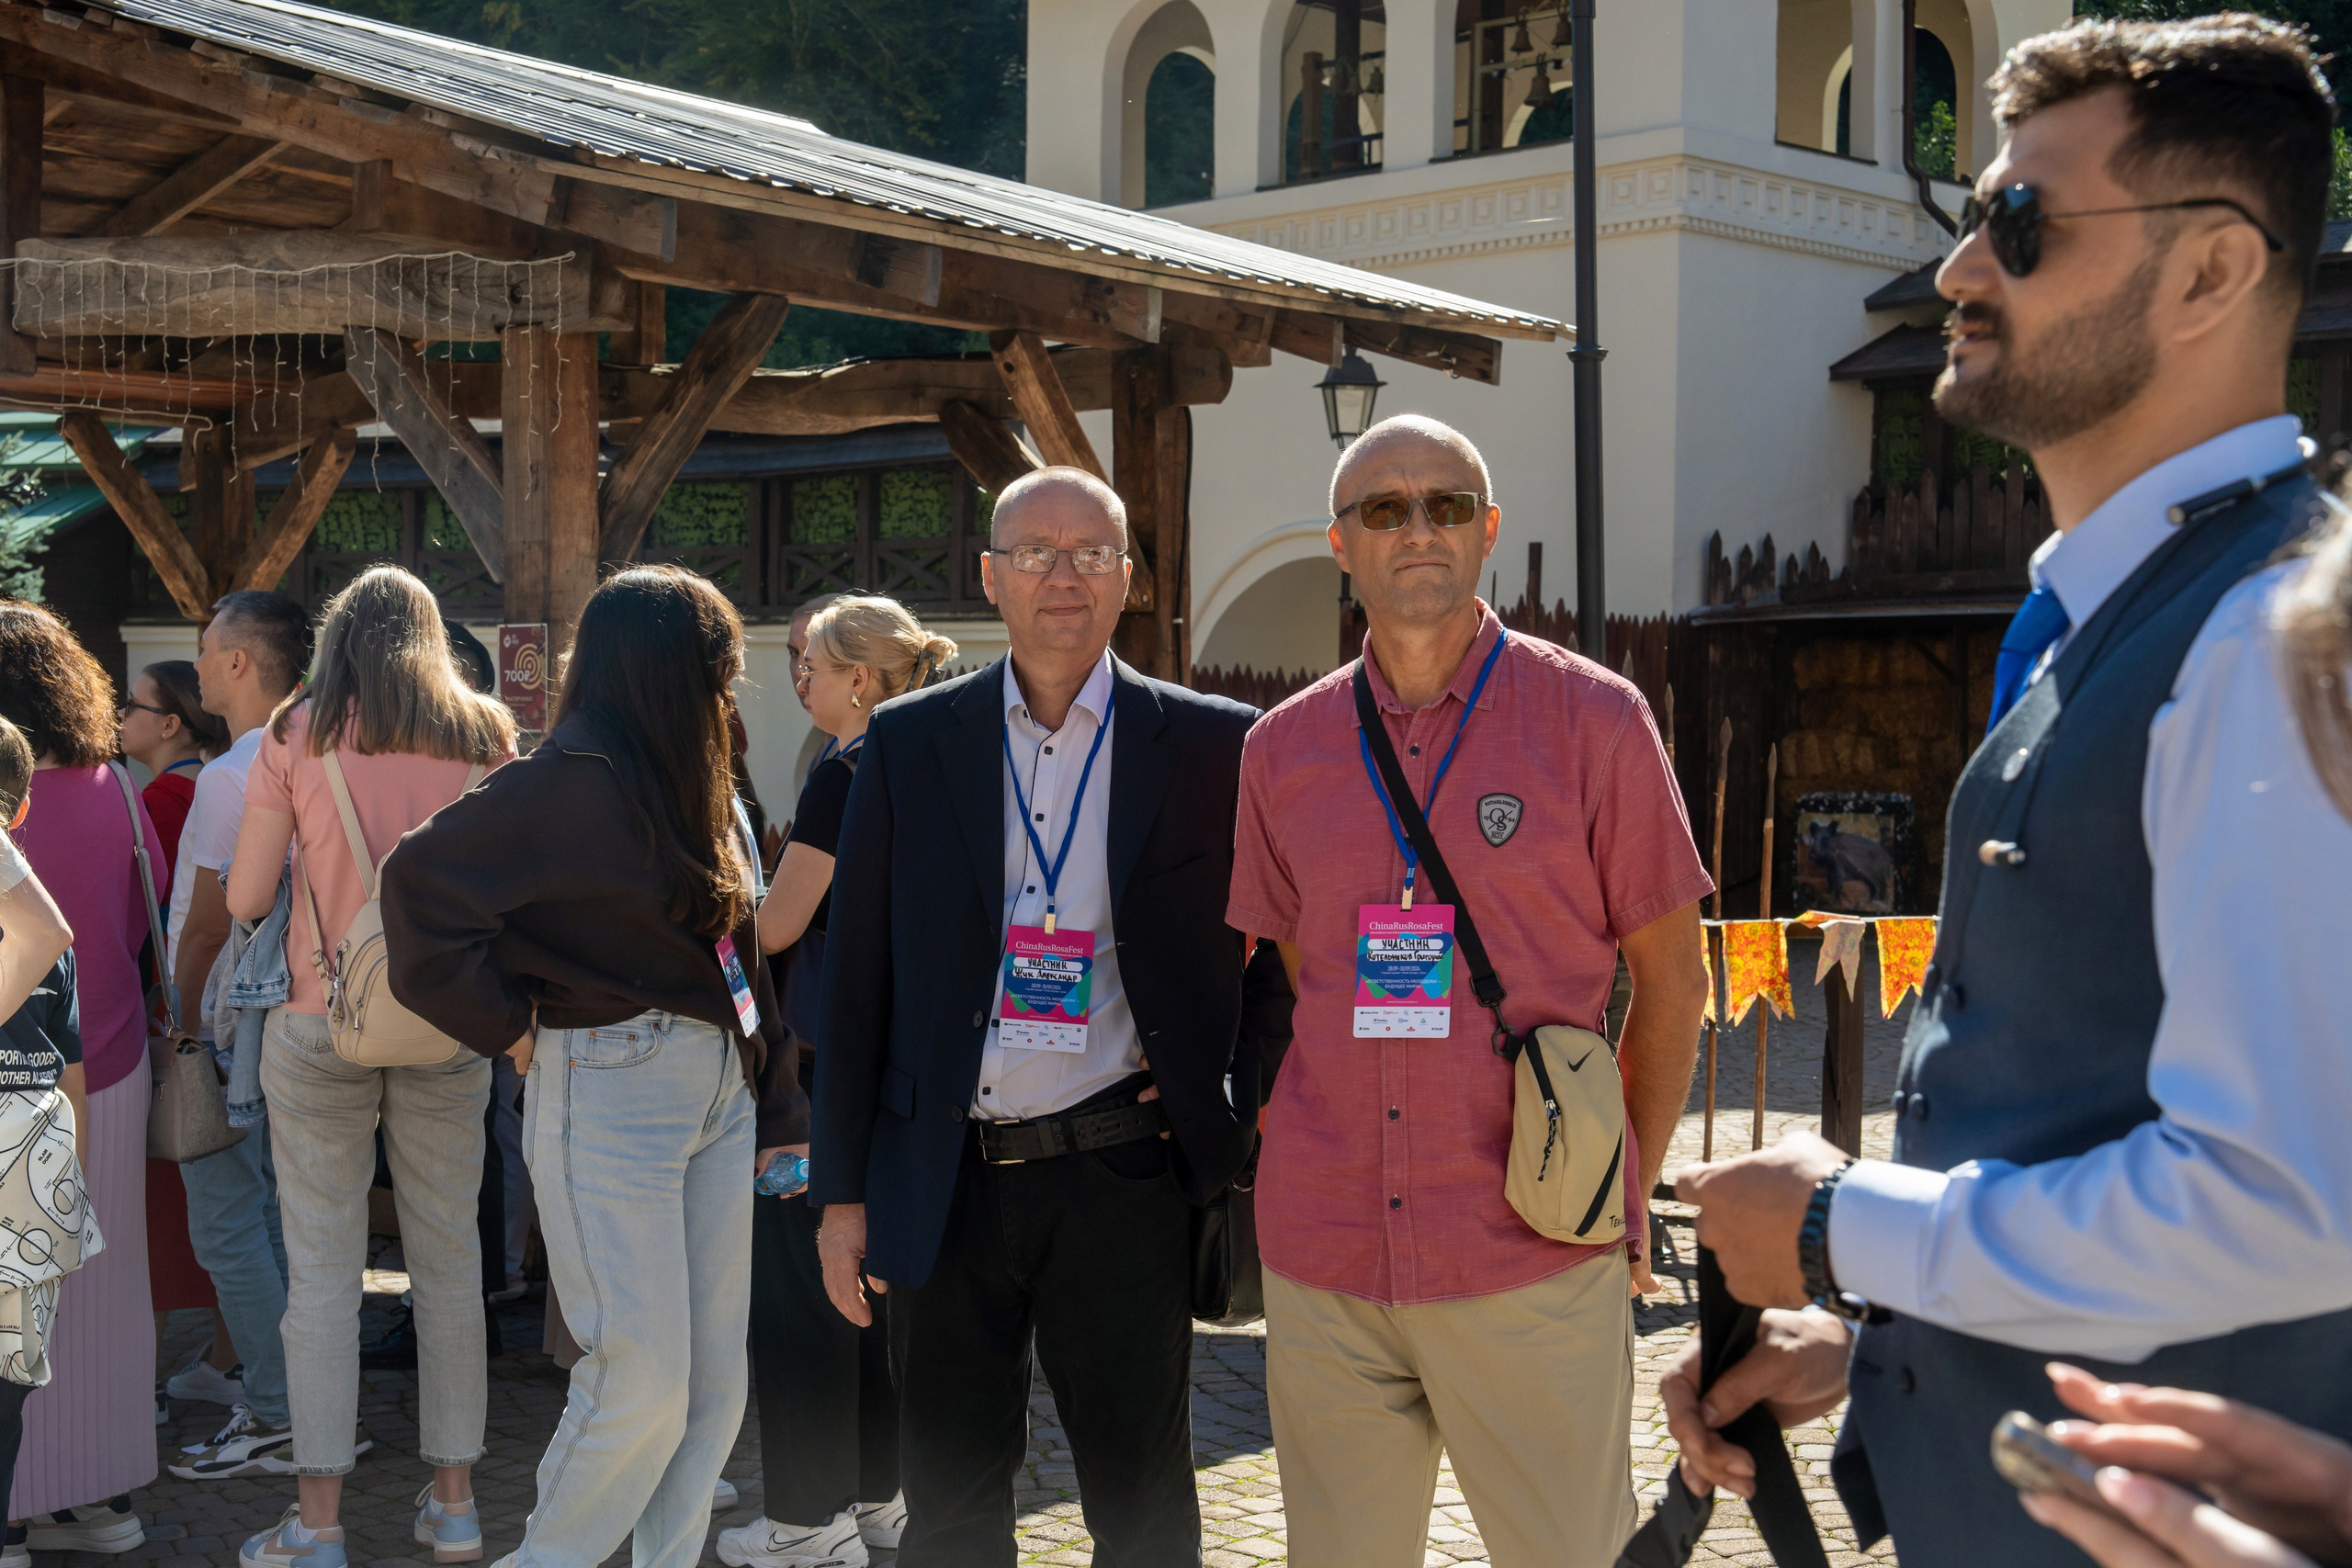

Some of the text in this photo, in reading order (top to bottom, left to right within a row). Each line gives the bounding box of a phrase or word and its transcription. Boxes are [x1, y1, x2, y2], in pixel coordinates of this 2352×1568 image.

[1485, 799, 1517, 808] ESTABLISHED
[1369, 921, 1443, 931] ChinaRusRosaFest
[1015, 941, 1084, 954] ChinaRusRosaFest
[28, 1051, 57, 1067] GOODS
[0, 1071, 31, 1085] OTHER
[38, 1148, 48, 1161] SLAM
[42, 1152, 53, 1165] DUNK
